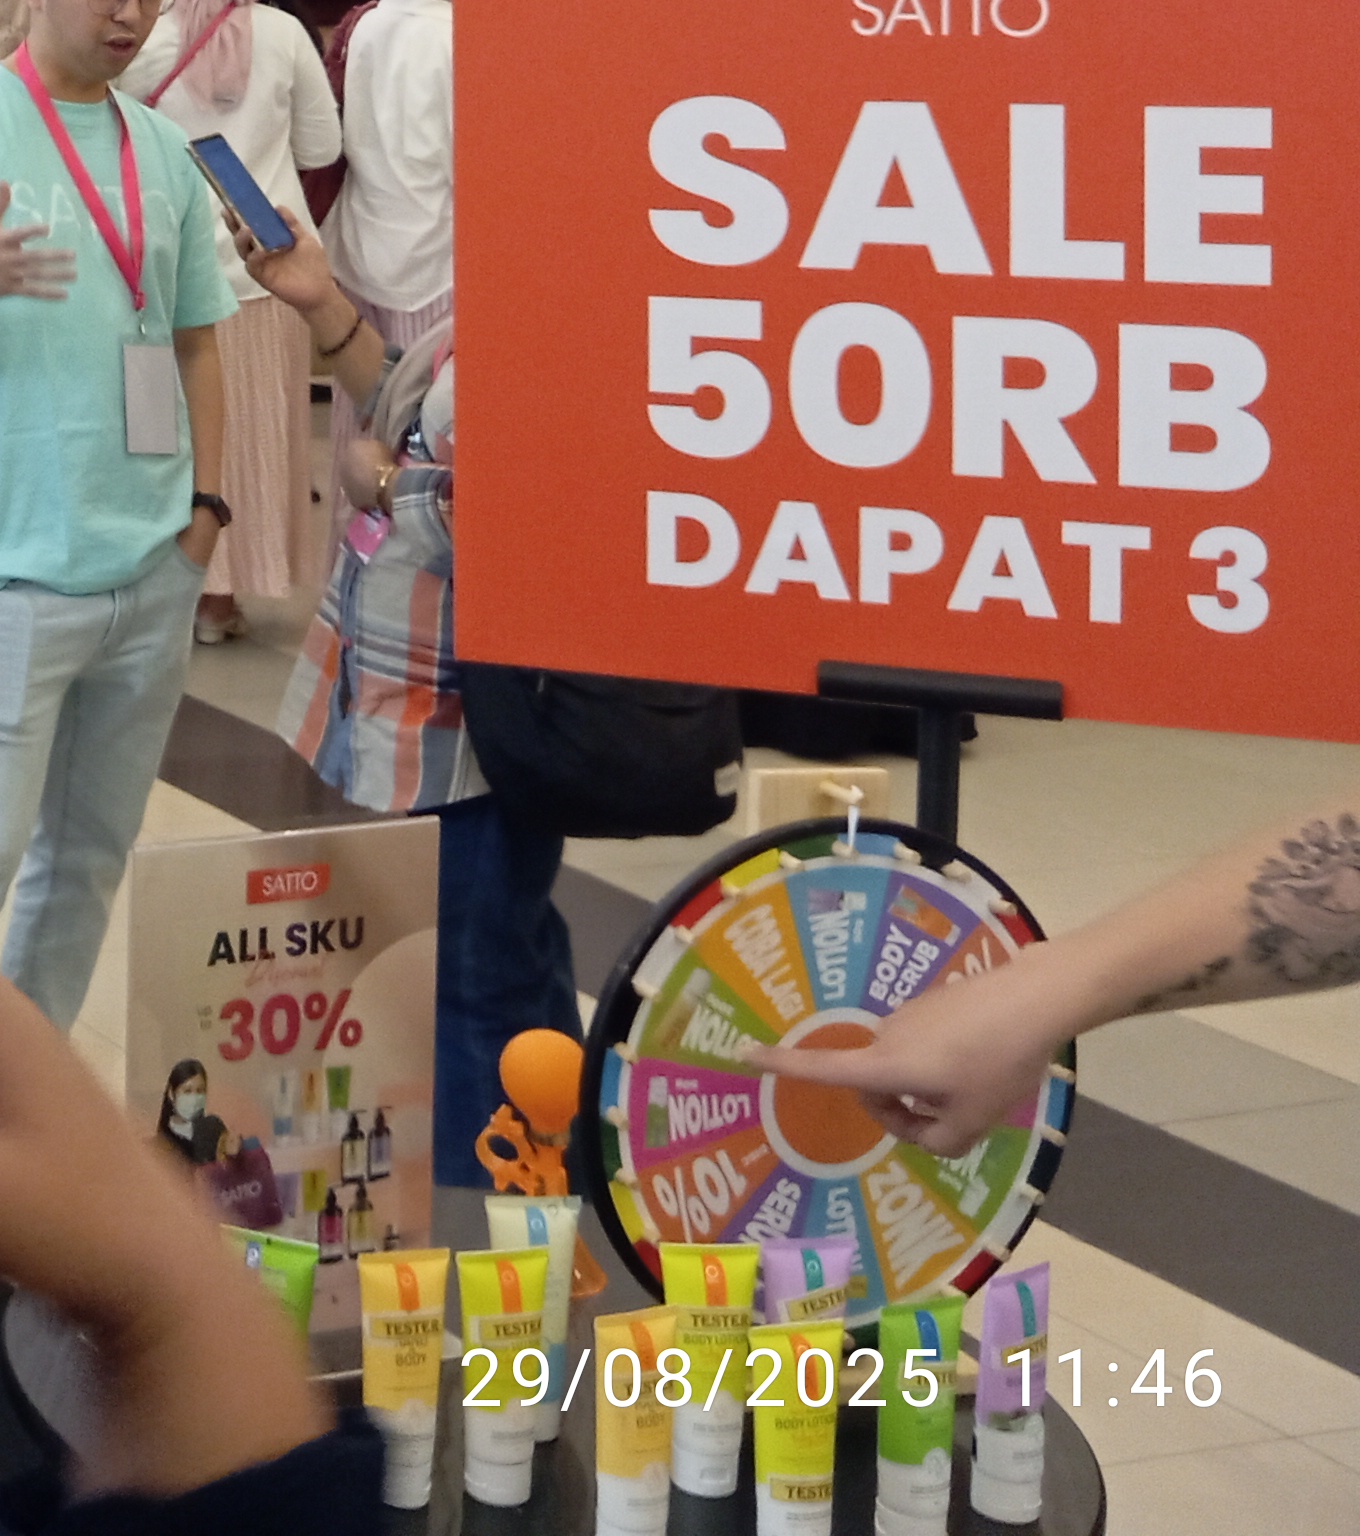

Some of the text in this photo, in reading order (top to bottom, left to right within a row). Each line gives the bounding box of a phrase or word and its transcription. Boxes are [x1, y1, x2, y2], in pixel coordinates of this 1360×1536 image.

[646, 95, 1273, 286] SALE
[646, 297, 1271, 493] 50RB
[646, 490, 1270, 634] DAPAT 3
[262, 871, 318, 896] SATTO
[207, 916, 364, 967] ALL SKU
[808, 909, 851, 1001] LOTION
[869, 922, 913, 1002] BODY
[886, 939, 940, 1010] SCRUB
[217, 988, 363, 1062] 30%
[681, 1003, 754, 1063] OTION
[668, 1092, 751, 1142] LOTION
[652, 1149, 747, 1244] 10%
[738, 1177, 802, 1243] SERU
[866, 1159, 966, 1290] ZONK
[384, 1319, 442, 1336] TESTER
[493, 1319, 542, 1337] TESTE
[691, 1314, 750, 1327] TESTER
[800, 1289, 847, 1315] TESTE
[683, 1332, 748, 1346] BODY LOTIO
[775, 1417, 804, 1430] BODY
[785, 1484, 833, 1499] TESTE
